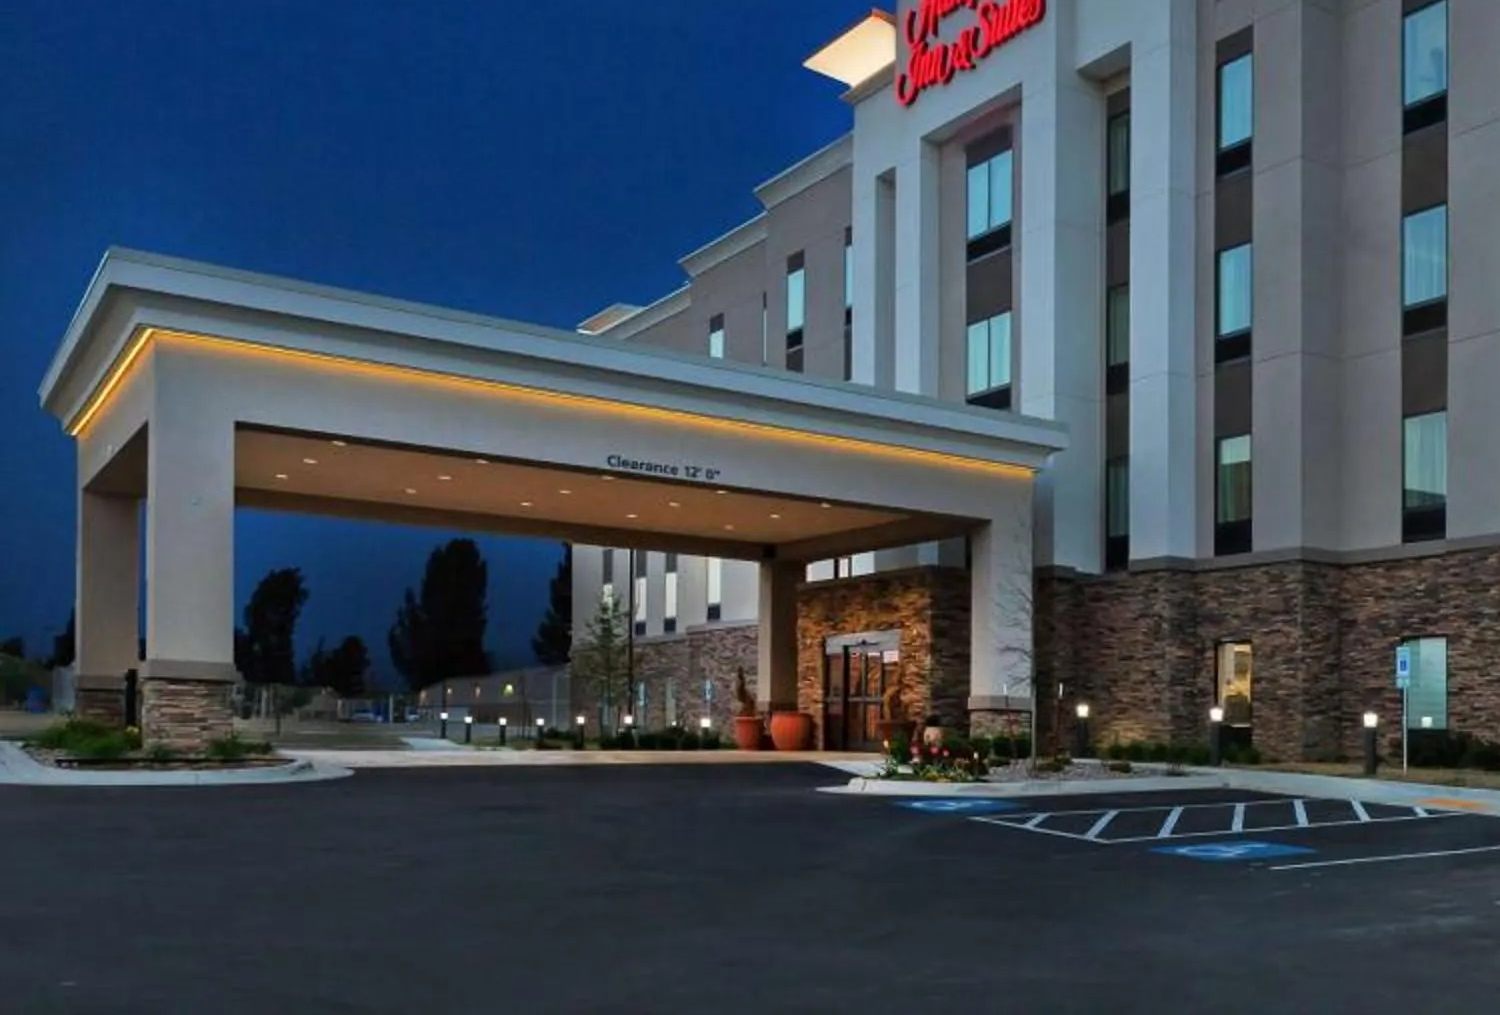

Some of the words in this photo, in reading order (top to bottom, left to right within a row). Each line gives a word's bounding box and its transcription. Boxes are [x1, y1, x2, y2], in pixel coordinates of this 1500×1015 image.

[896, 42, 955, 106] Inn
[951, 29, 976, 71] &
[607, 454, 679, 476] Clearance
